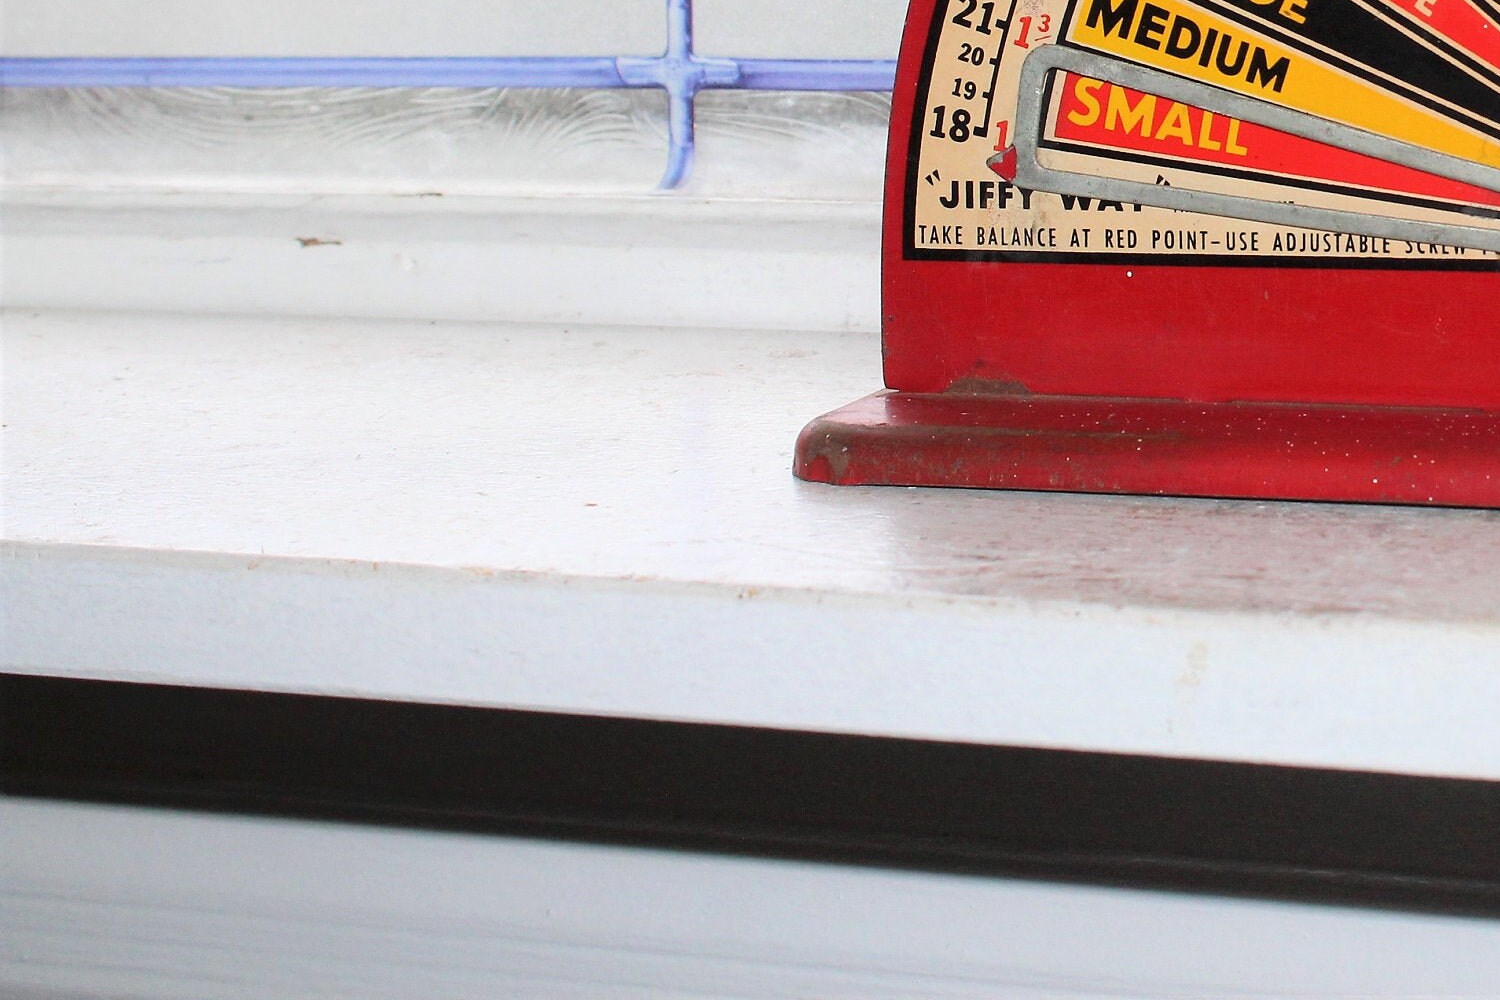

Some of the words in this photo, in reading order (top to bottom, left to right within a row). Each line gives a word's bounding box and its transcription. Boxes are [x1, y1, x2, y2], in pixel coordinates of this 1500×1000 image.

[957, 42, 985, 67] 20
[951, 78, 977, 100] 19
[929, 105, 971, 143] 18
[1067, 76, 1248, 156] SMALL
[918, 225, 963, 245] TAKE
[977, 226, 1057, 247] BALANCE
[1070, 228, 1091, 248] AT
[1105, 229, 1137, 249] RED
[1272, 232, 1390, 254] ADJUSTABLE
